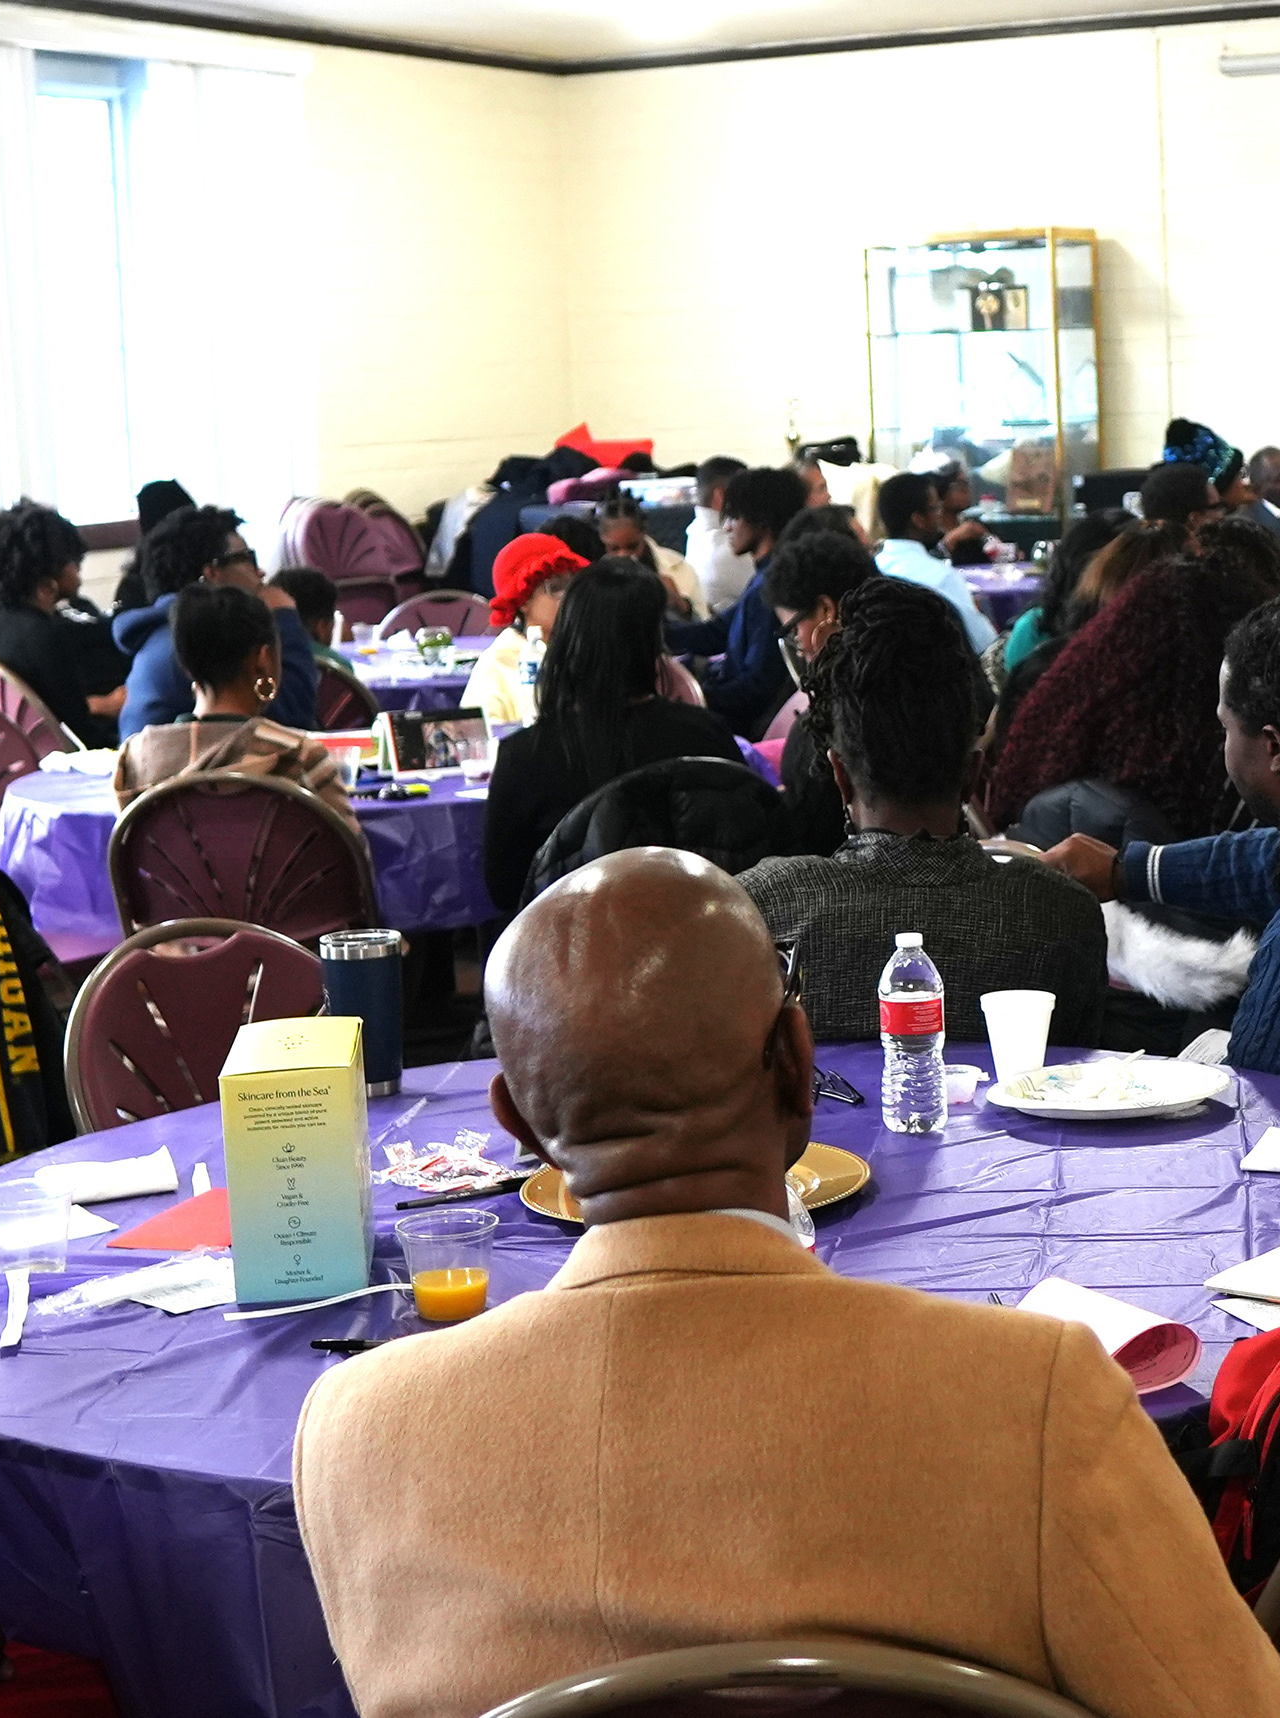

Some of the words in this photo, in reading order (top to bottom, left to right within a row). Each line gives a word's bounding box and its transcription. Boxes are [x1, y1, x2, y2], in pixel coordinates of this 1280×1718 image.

[238, 1092, 274, 1101] Skincare
[275, 1090, 296, 1099] from
[298, 1088, 311, 1097] the
